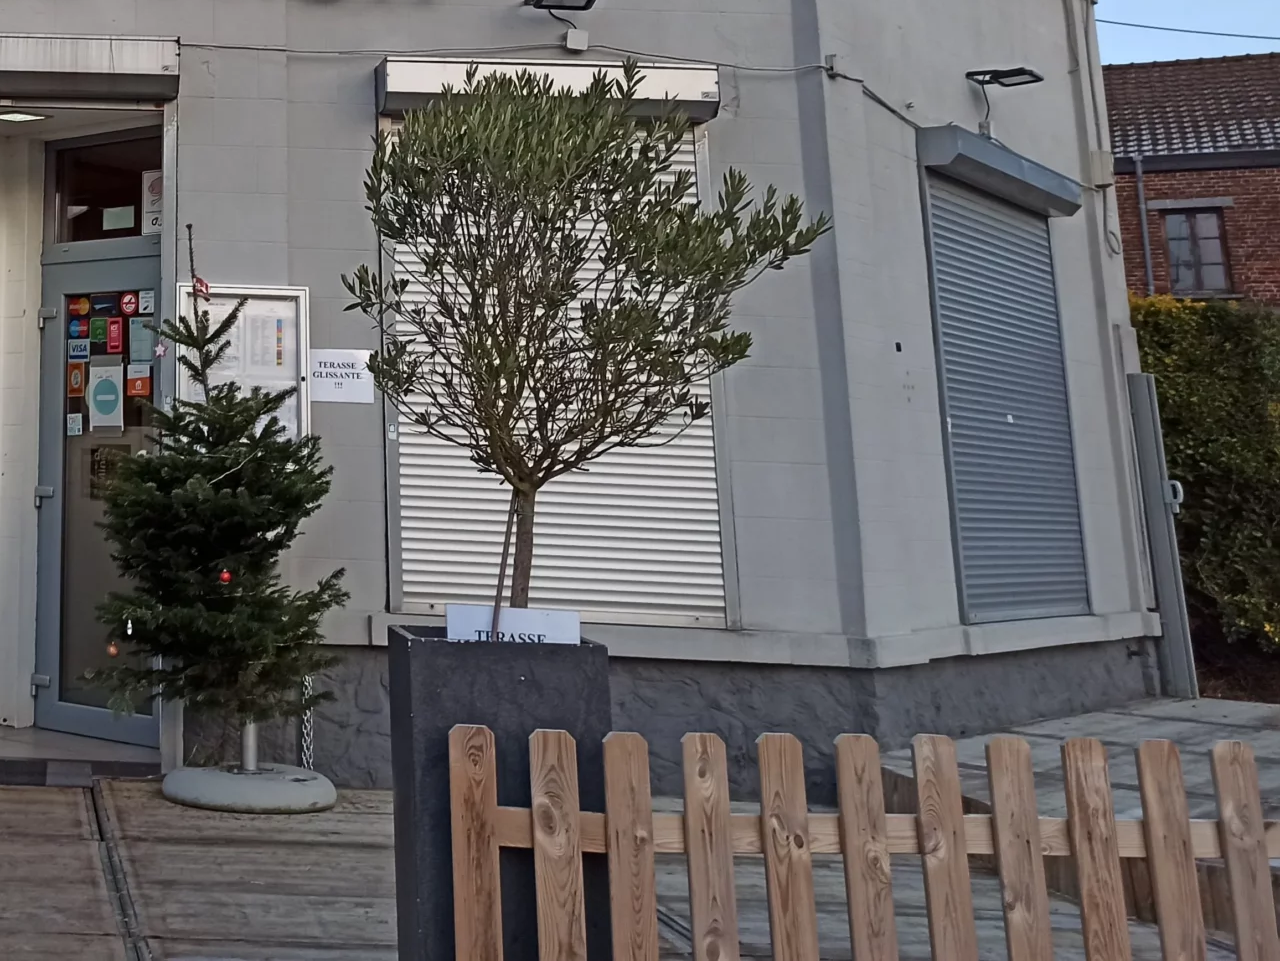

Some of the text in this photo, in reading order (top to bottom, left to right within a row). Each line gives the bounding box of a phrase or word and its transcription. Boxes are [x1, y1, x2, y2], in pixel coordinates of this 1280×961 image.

[71, 344, 88, 353] VISA
[317, 360, 357, 370] TERASSE
[312, 370, 363, 380] GLISSANTE
[333, 381, 343, 390] !!!
